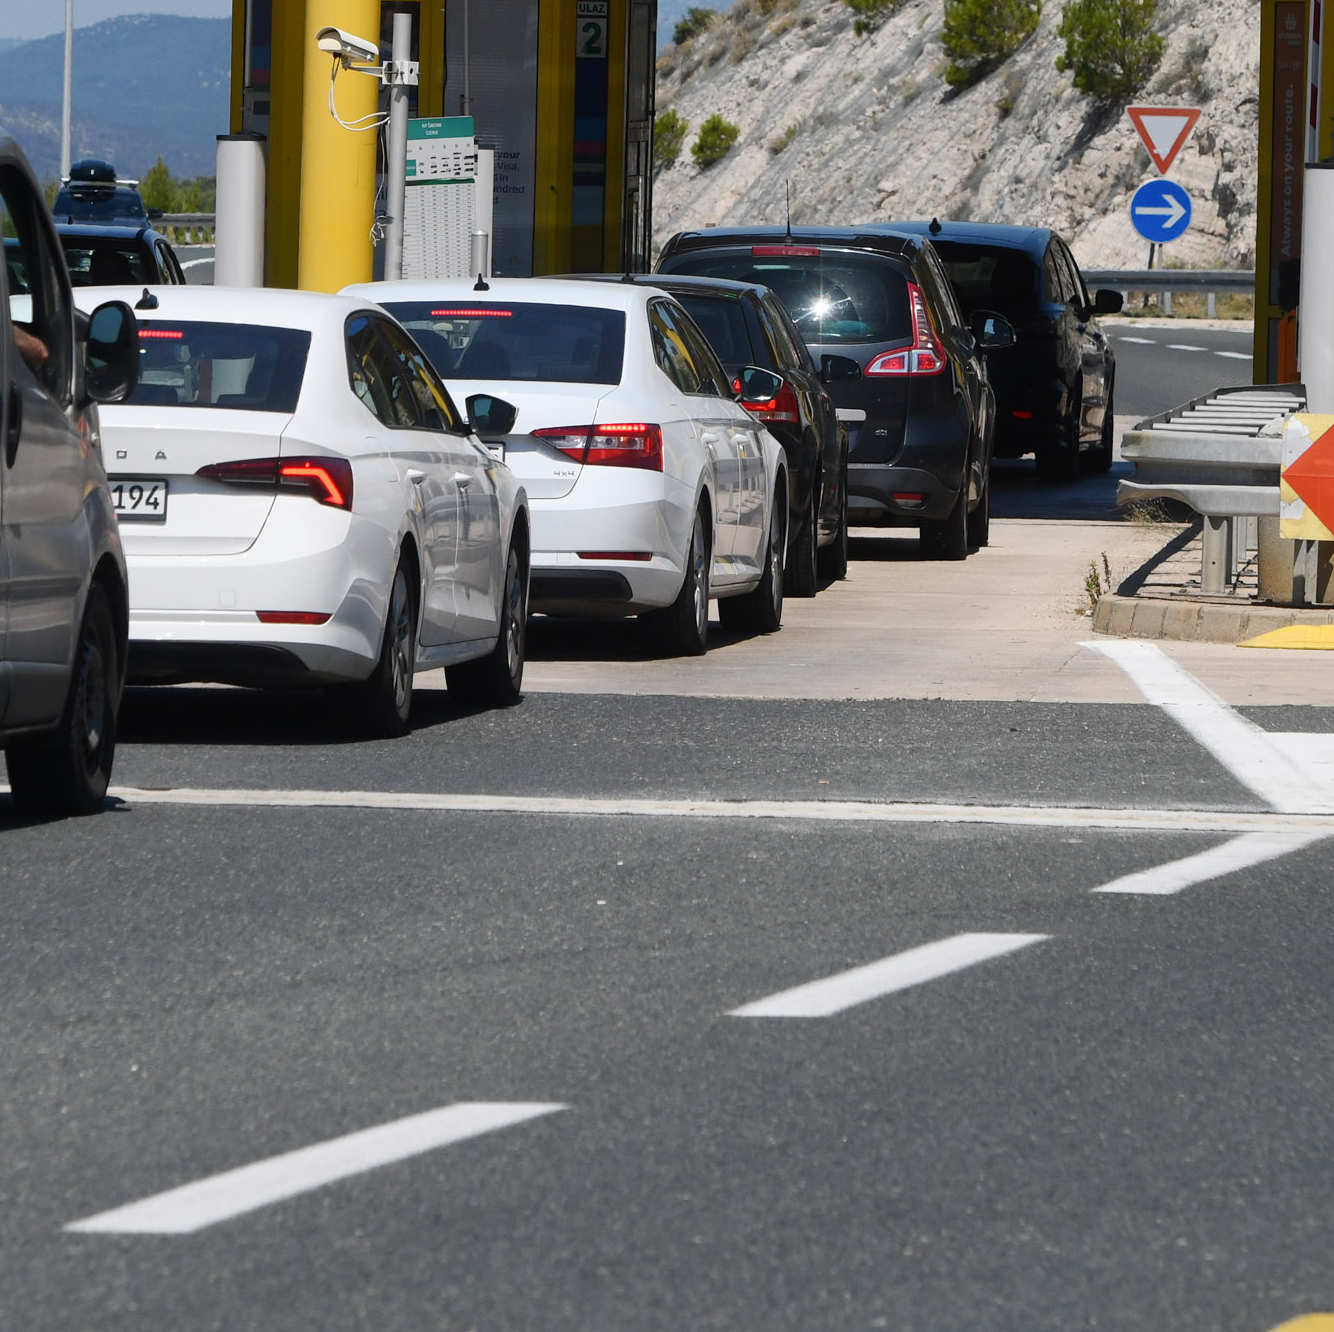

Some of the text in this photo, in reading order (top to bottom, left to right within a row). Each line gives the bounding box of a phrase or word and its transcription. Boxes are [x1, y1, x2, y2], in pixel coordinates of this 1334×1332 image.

[579, 3, 606, 13] ULAZ
[581, 22, 602, 54] 2
[1284, 84, 1294, 129] route.
[496, 152, 521, 161] your
[1284, 135, 1295, 172] your
[1283, 176, 1292, 195] on
[1281, 199, 1294, 257] Always
